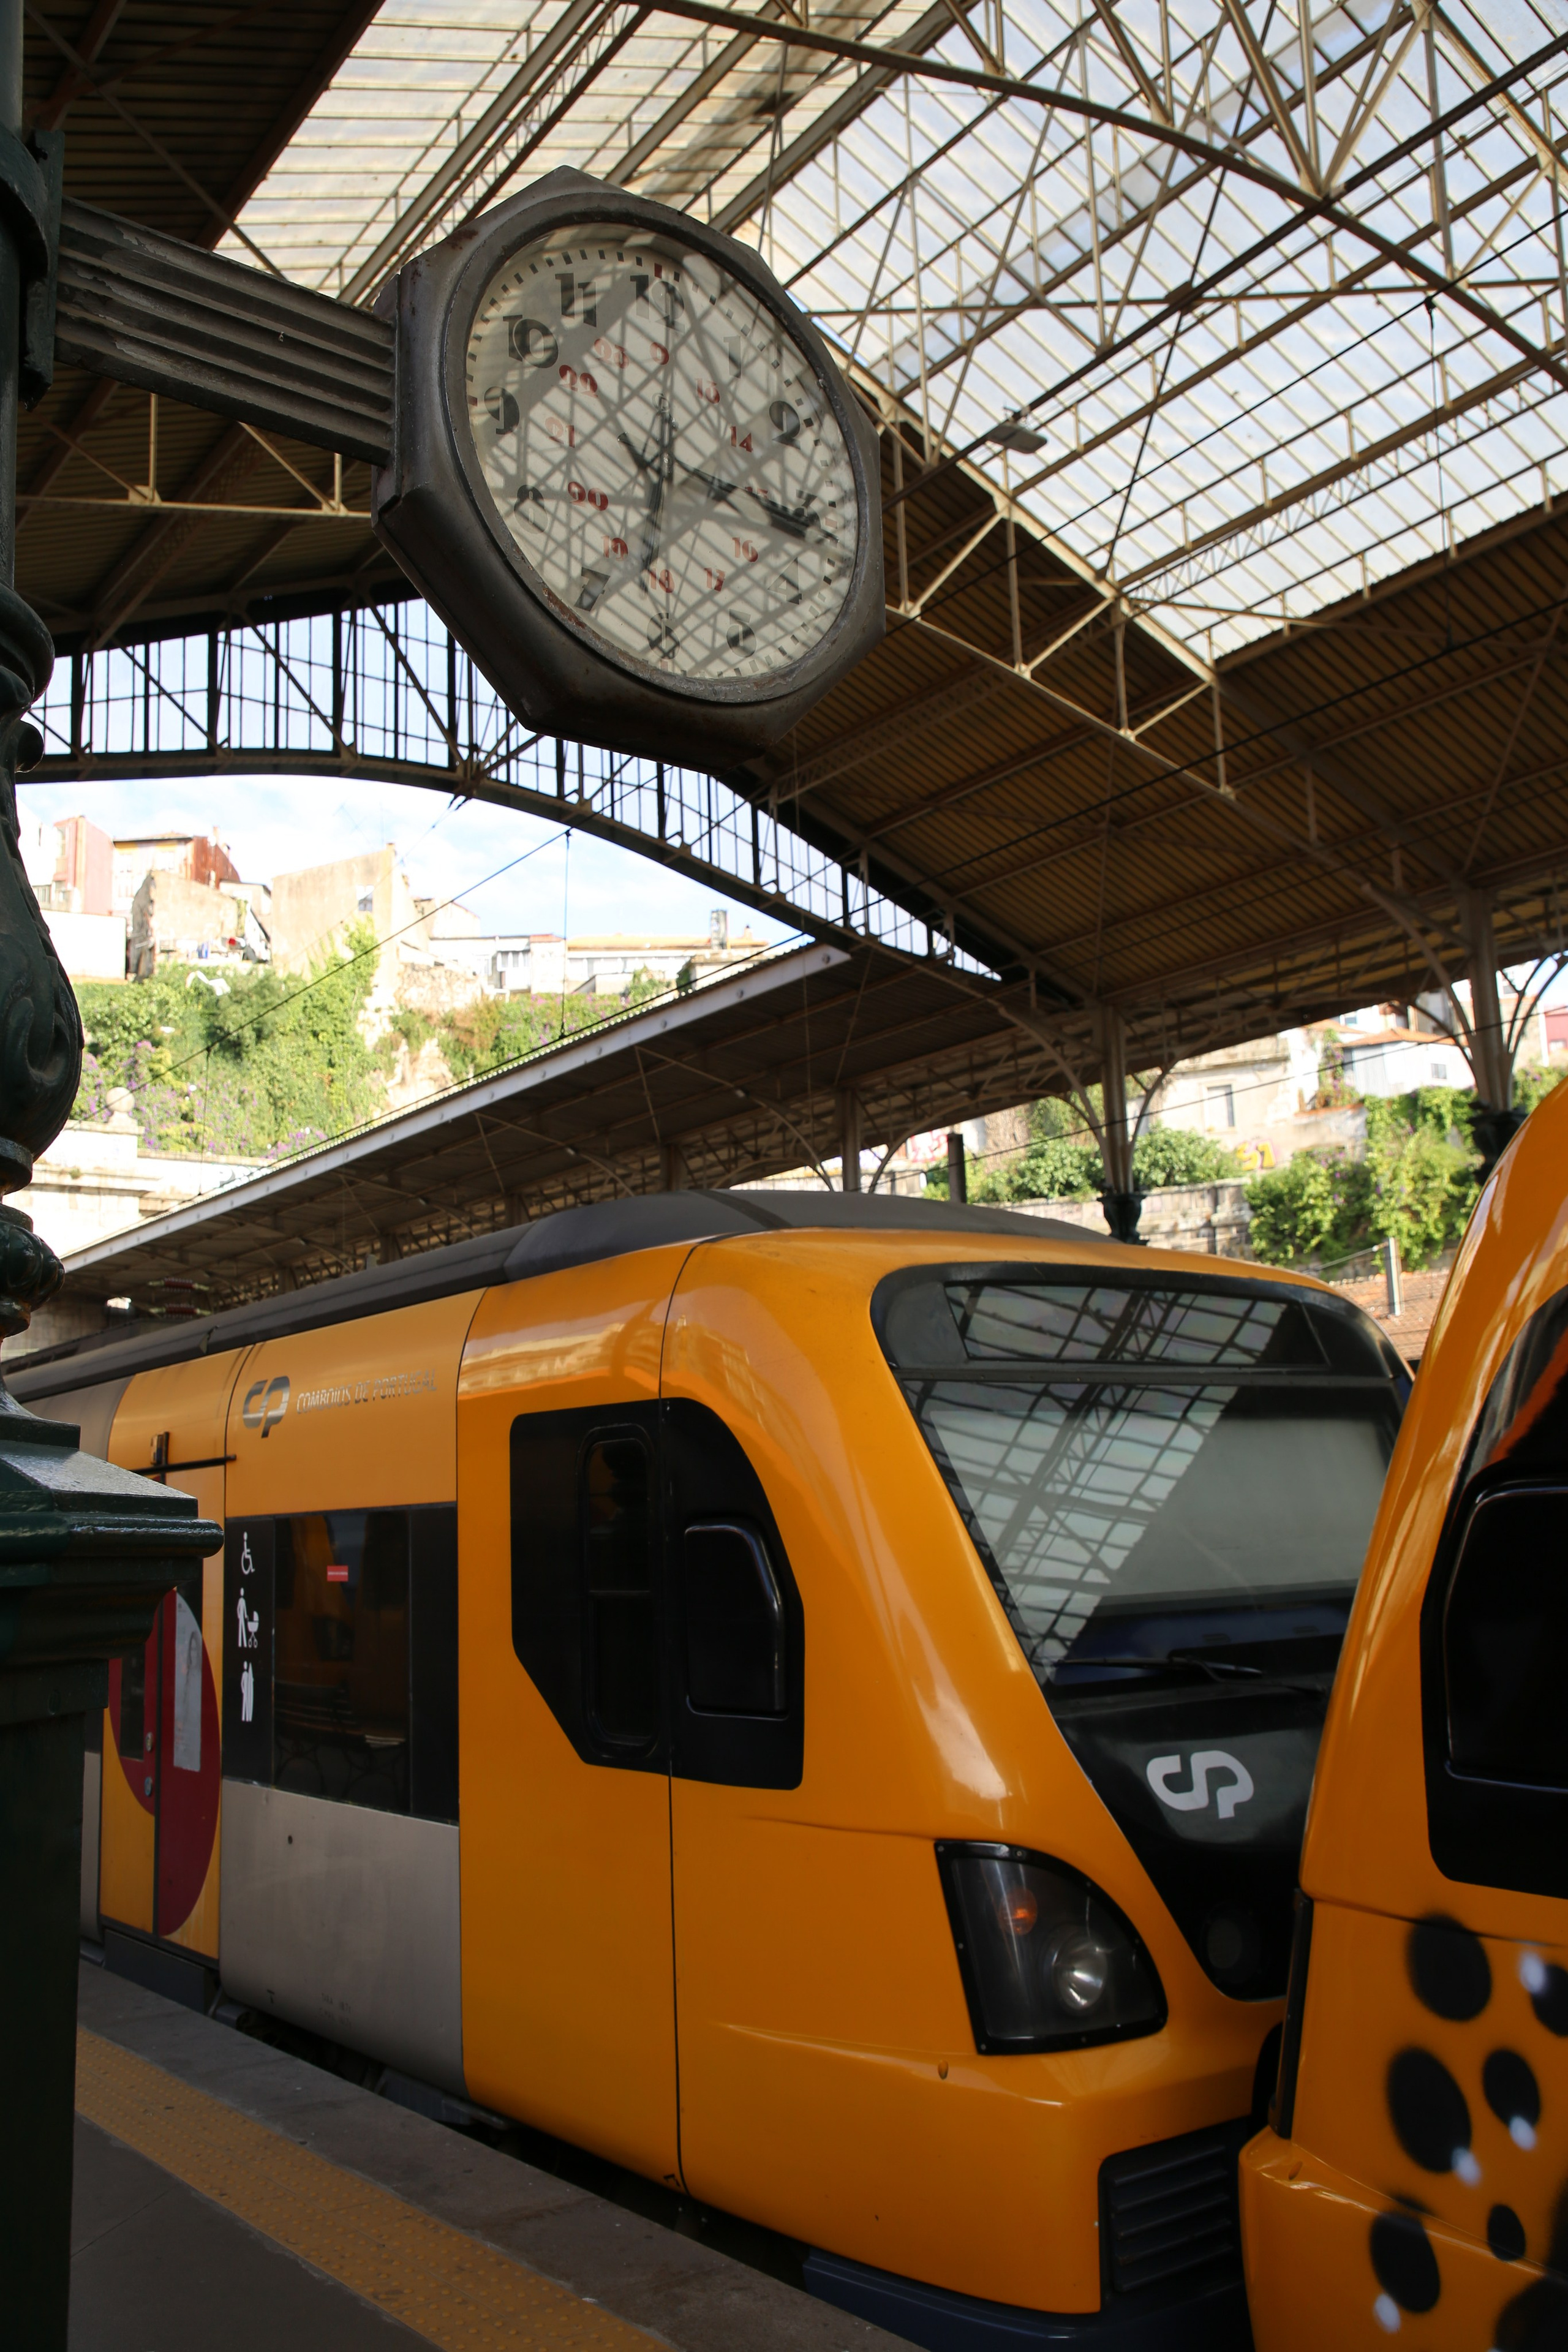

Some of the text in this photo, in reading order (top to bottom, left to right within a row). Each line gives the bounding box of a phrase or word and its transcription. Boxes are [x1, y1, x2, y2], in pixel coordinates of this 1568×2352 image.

[555, 273, 597, 327] 11
[630, 274, 685, 334] 12
[503, 314, 559, 369] 10
[723, 336, 741, 378] 1
[559, 364, 598, 398] 22
[484, 386, 519, 435] 9
[545, 417, 575, 448] 21
[769, 401, 801, 450] 2
[731, 426, 753, 453] 14
[514, 484, 548, 534] 8
[568, 481, 609, 511] 20
[601, 535, 628, 562] 19
[733, 537, 758, 562] 16
[573, 567, 611, 612] 7
[649, 566, 675, 593] 18
[704, 568, 725, 592] 17
[767, 557, 802, 605] 4
[647, 612, 680, 659] 6
[726, 609, 757, 657] 5
[296, 1369, 437, 1414] COMBOIOS DE PORTUGAL
